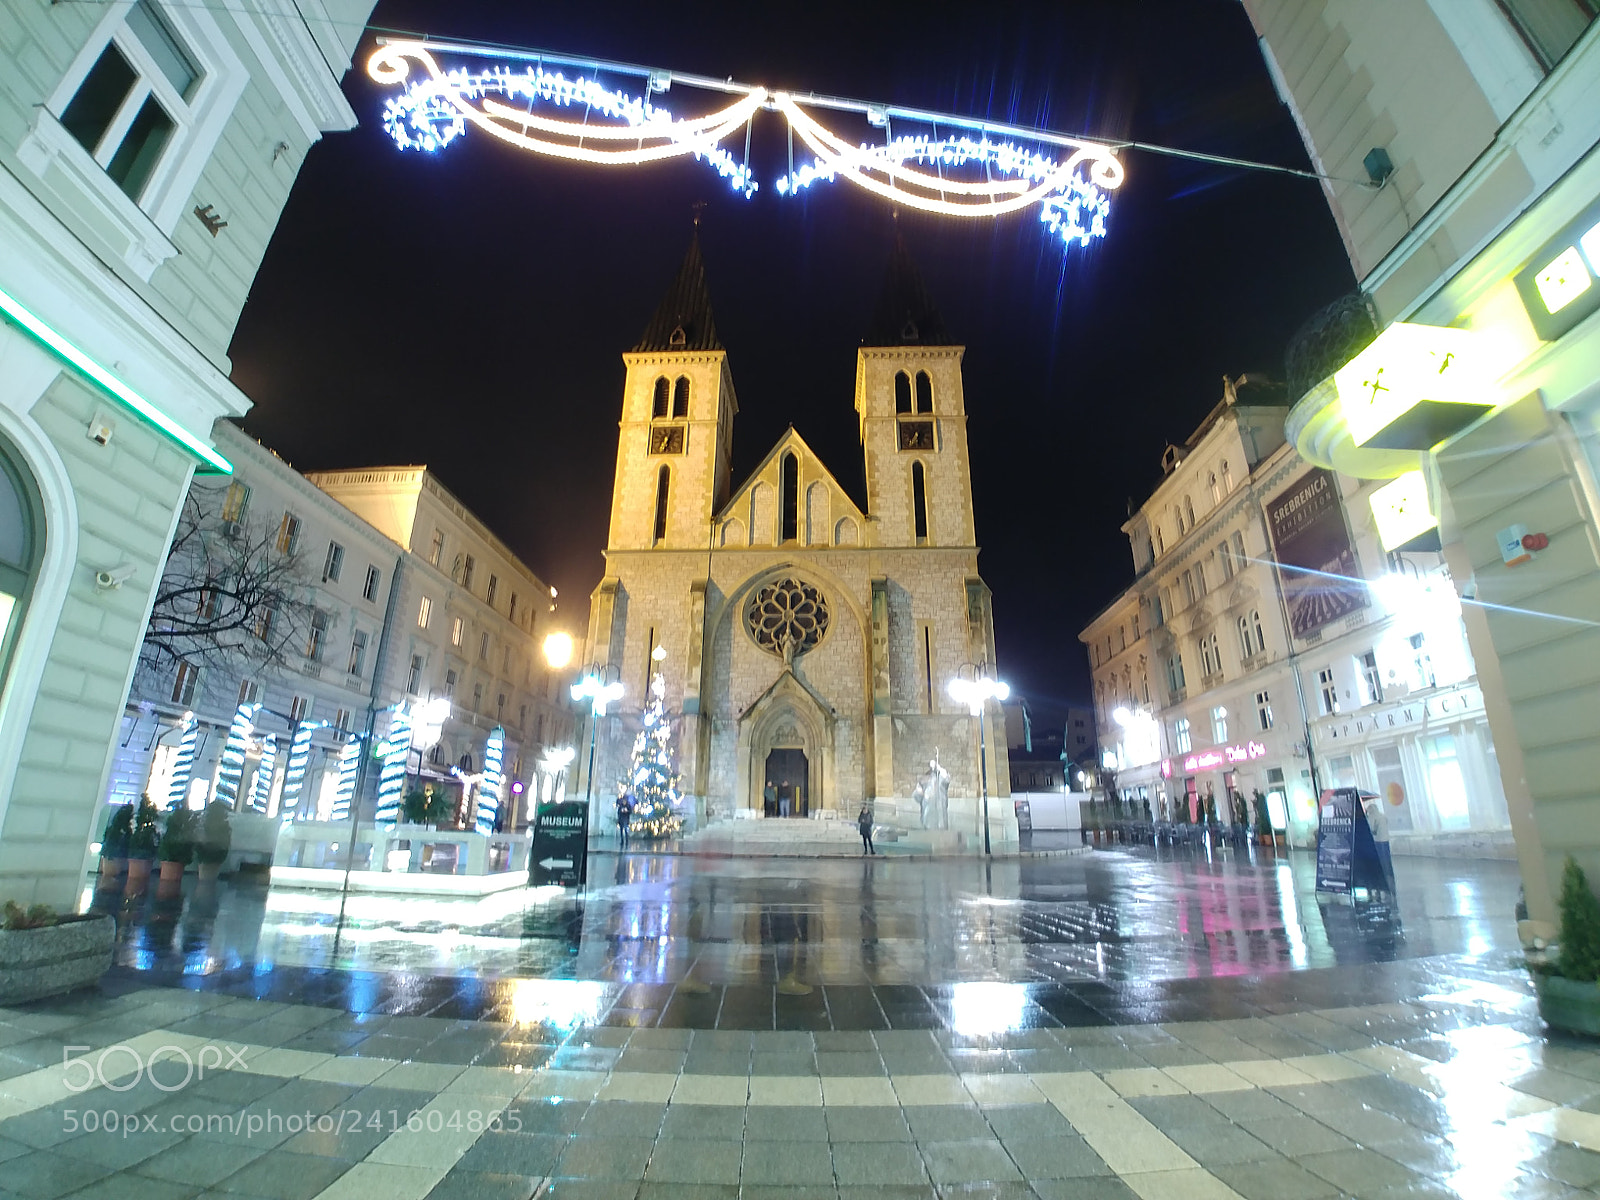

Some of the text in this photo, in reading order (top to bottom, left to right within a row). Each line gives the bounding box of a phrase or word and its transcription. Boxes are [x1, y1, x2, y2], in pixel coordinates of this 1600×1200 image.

[1273, 475, 1328, 524] SREBRENICA
[1343, 694, 1468, 737] PHARMACY
[541, 816, 583, 827] MUSEUM
